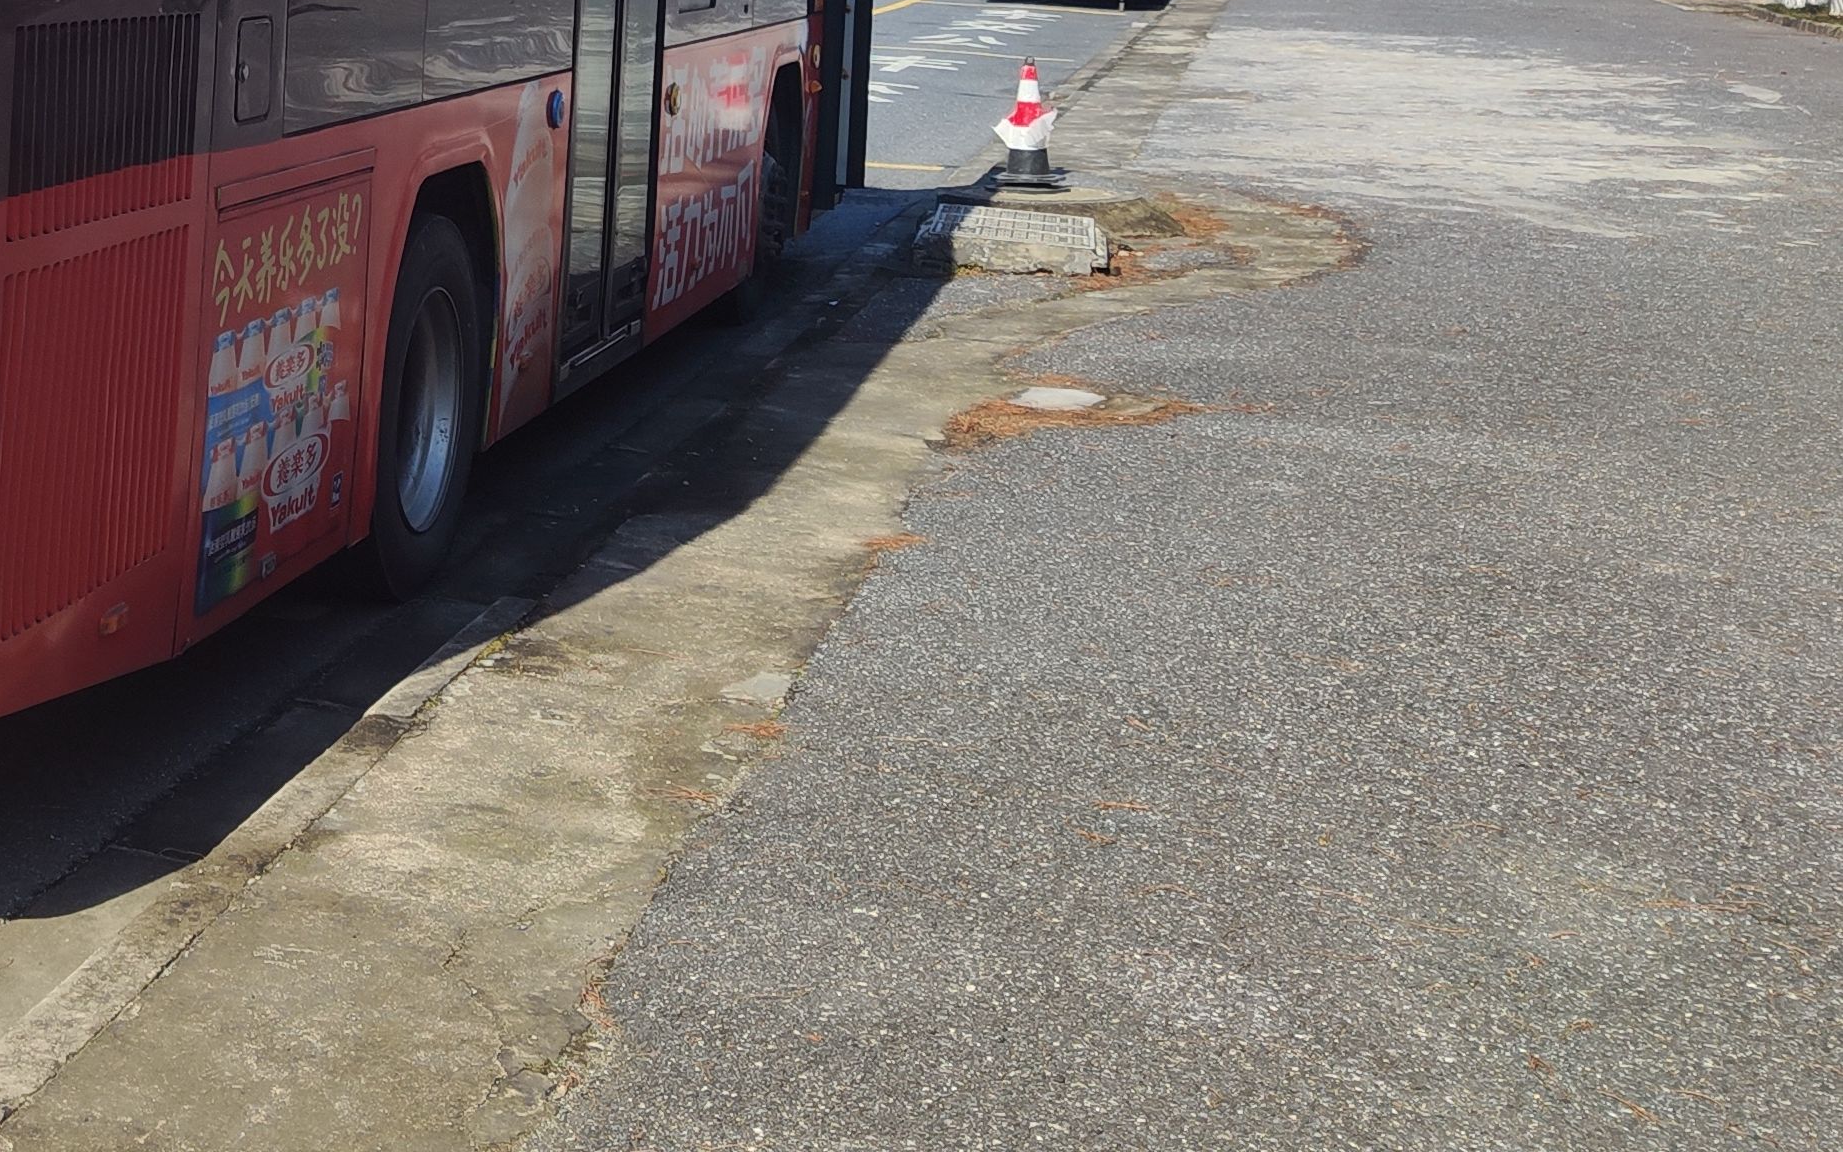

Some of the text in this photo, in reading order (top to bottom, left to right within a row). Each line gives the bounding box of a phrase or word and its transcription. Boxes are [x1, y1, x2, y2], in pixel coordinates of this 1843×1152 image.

[652, 159, 756, 310] 活力为不凡
[272, 384, 306, 413] Yakult
[270, 483, 317, 528] Yakult
